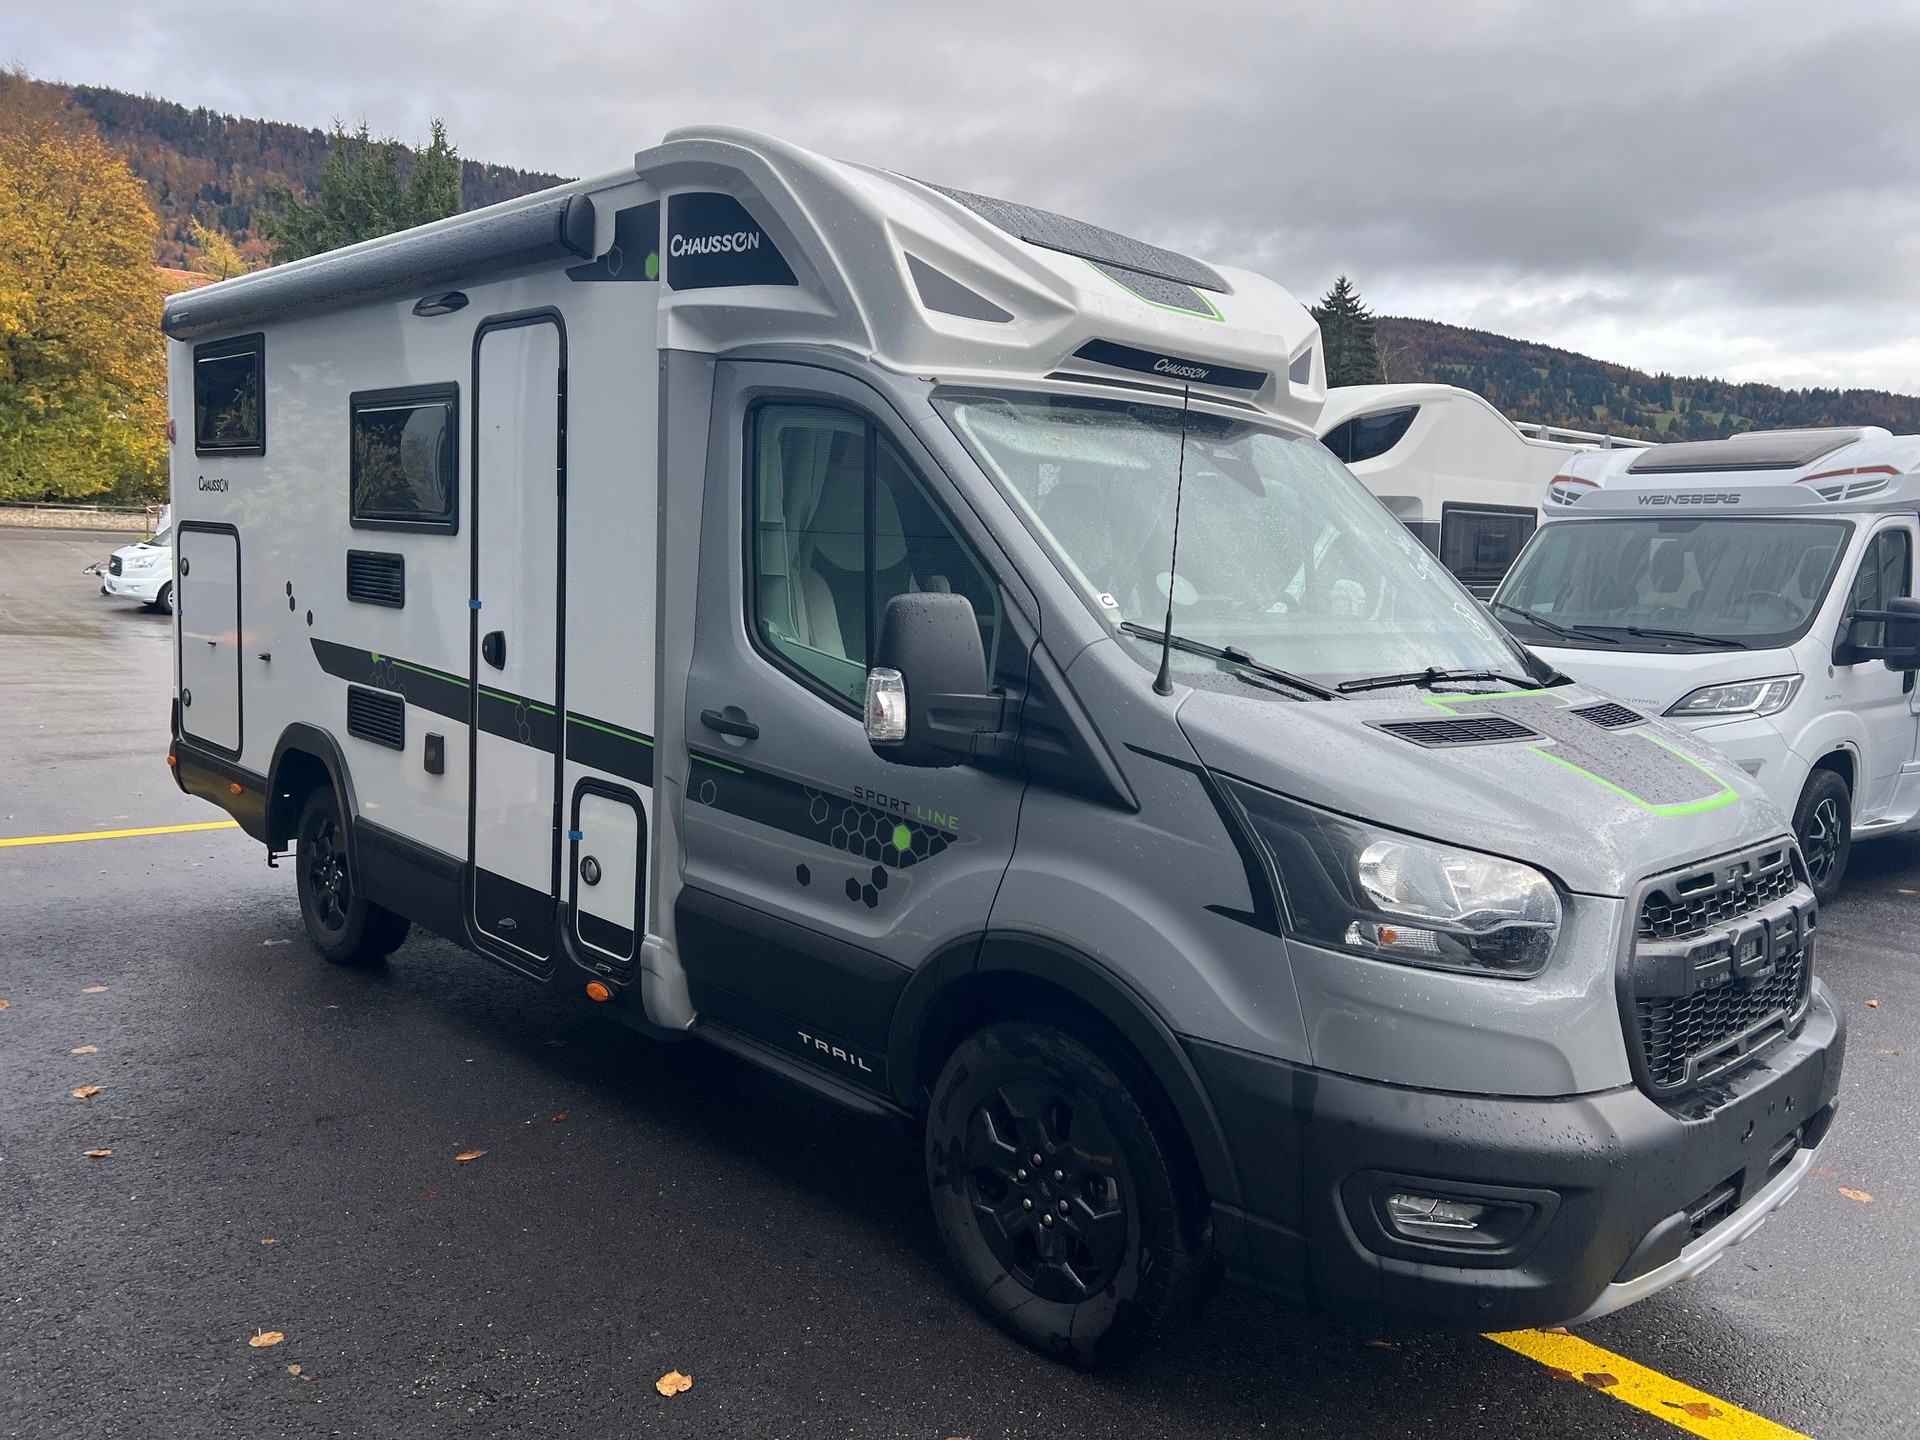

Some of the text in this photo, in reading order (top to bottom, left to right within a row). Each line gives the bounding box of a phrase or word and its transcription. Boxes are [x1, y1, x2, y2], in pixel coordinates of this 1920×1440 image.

[669, 231, 761, 258] CHAUSSON
[1153, 358, 1210, 379] CHAUSSON
[1637, 493, 1742, 506] WEINSBERG
[854, 785, 960, 831] SPORT LINE
[797, 1030, 872, 1073] TRAIL
